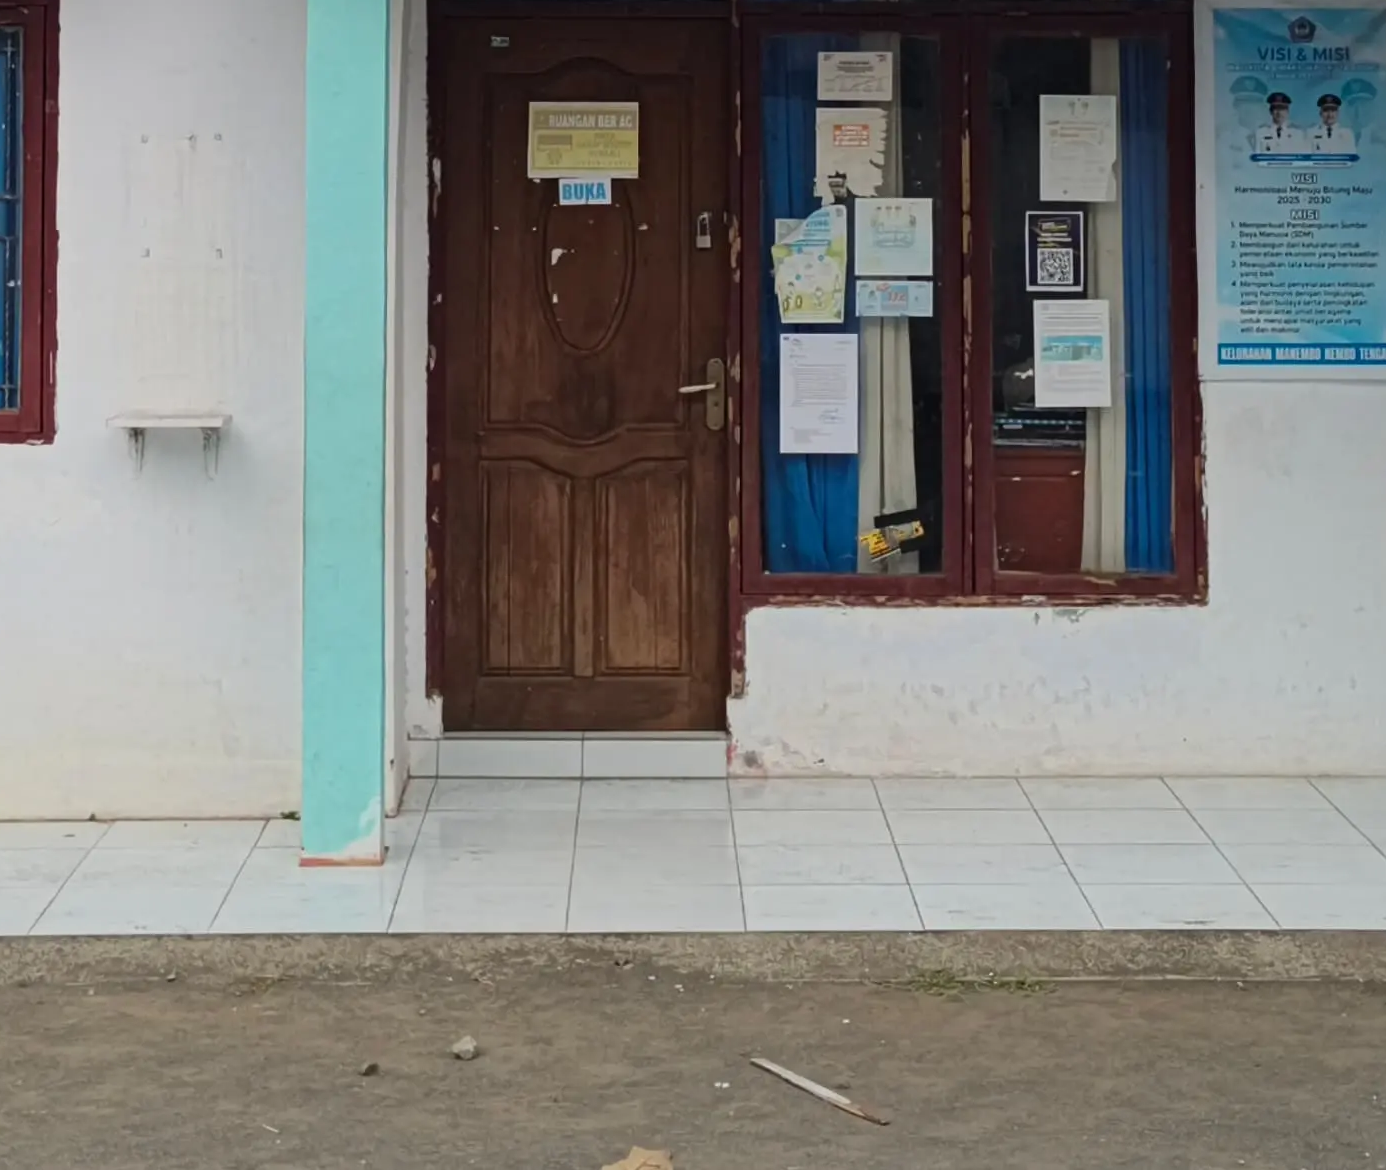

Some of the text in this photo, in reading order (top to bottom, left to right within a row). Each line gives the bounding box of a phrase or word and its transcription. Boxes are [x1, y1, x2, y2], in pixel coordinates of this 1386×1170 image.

[1257, 46, 1351, 61] VISI & MISI
[549, 114, 596, 127] RUANGAN
[1291, 172, 1317, 184] VISI
[562, 182, 606, 200] BUKA
[1277, 196, 1331, 204] 2025 2030
[1290, 209, 1320, 220] MISI
